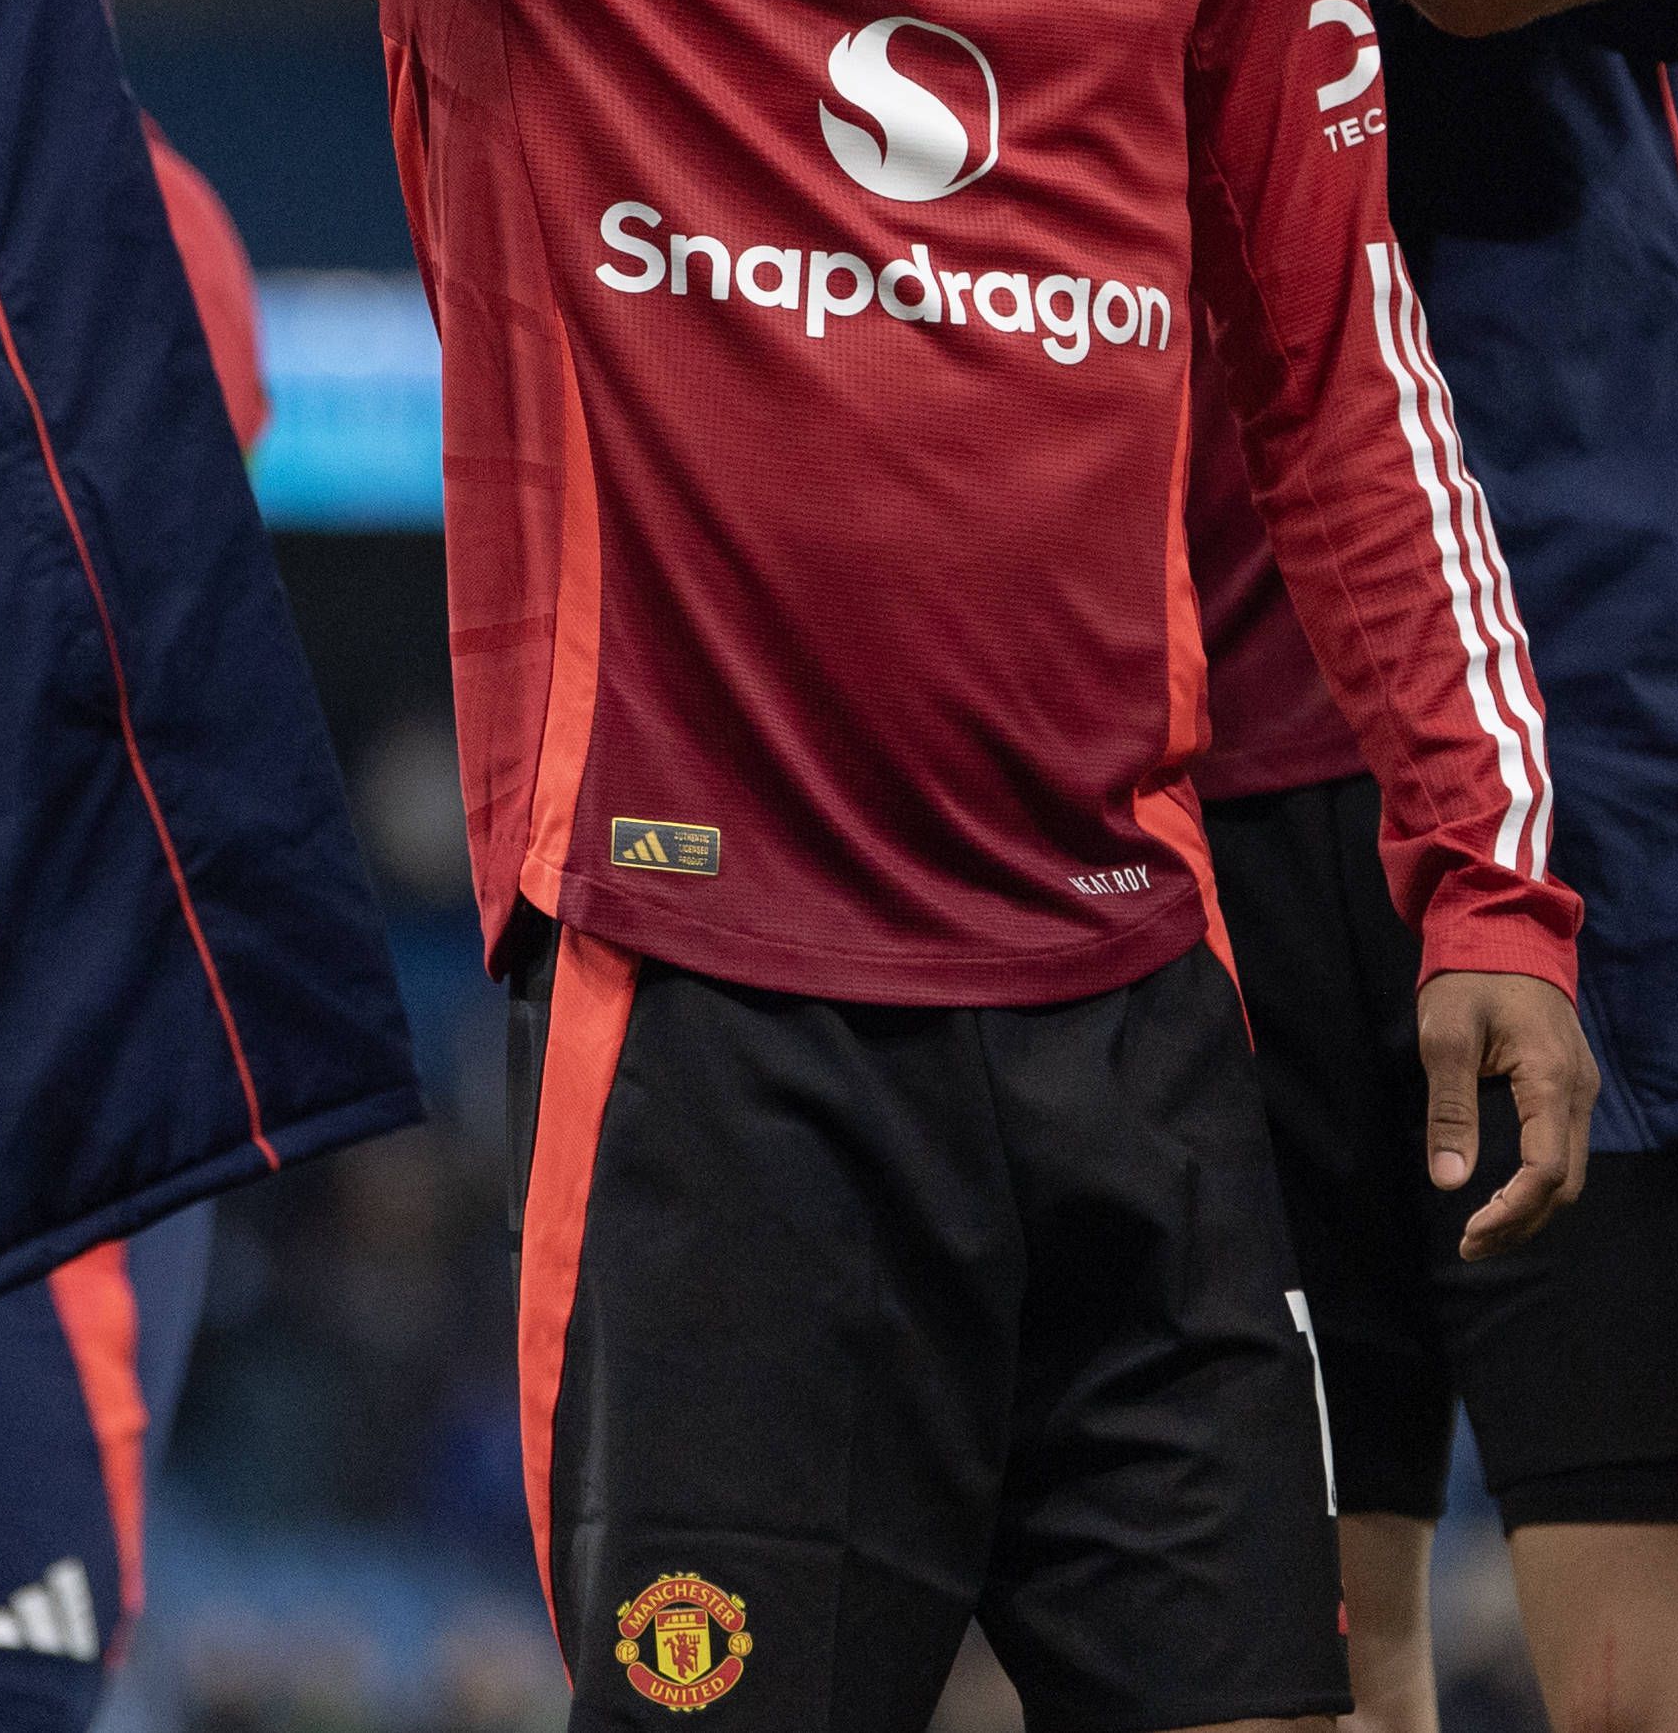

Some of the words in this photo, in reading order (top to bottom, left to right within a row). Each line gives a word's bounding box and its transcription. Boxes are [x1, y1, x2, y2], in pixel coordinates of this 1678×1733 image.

[595, 200, 1172, 365] Snapdragon
[1067, 864, 1151, 895] HEAT.RDY
[627, 1583, 736, 1631] MANCHESTER
[649, 1676, 726, 1703] UNITED
